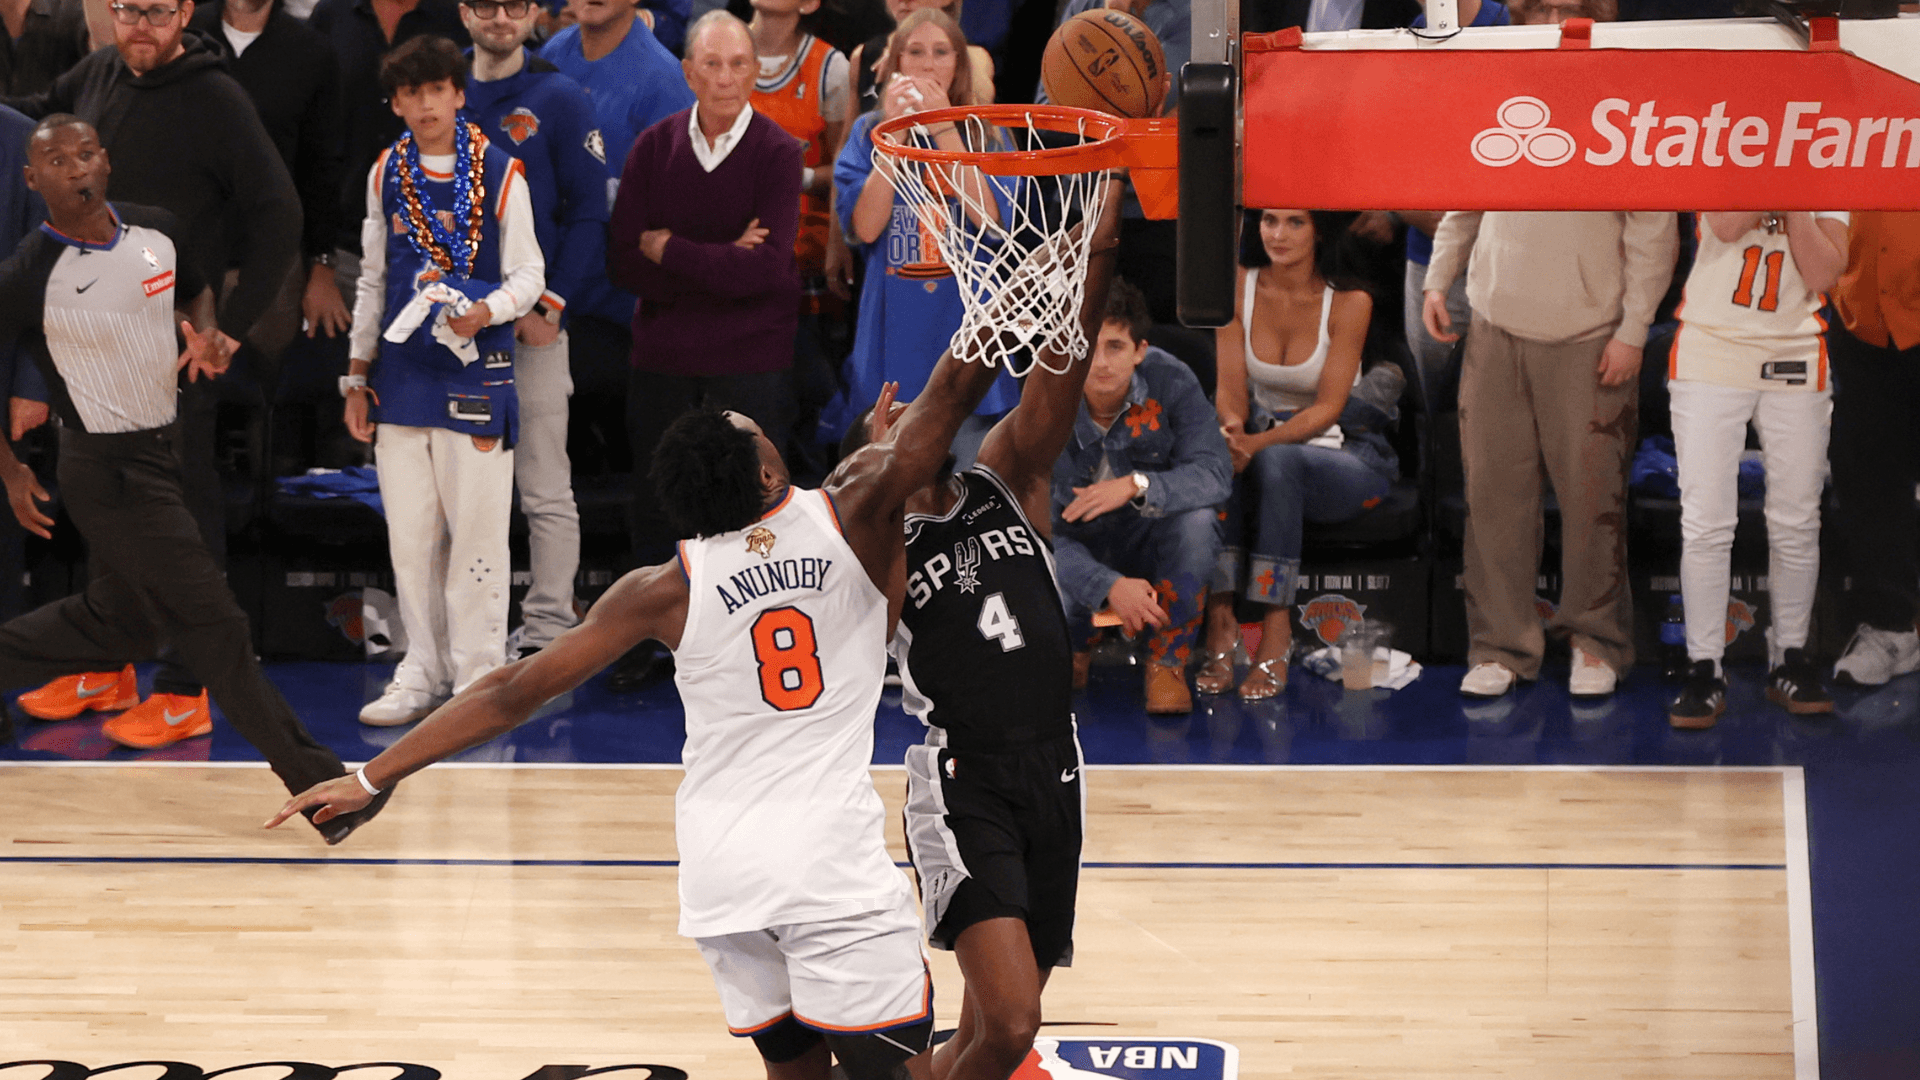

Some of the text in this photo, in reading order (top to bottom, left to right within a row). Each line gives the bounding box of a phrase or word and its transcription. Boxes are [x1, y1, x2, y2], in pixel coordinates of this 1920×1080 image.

[1103, 12, 1158, 80] Wilson
[1732, 244, 1785, 312] 11
[967, 500, 996, 520] LEDGER
[716, 557, 833, 615] ANUNOBY
[906, 525, 1035, 610] SPURS
[977, 592, 1026, 653] 4
[750, 605, 825, 711] 8
[1087, 1045, 1199, 1070] NBA
